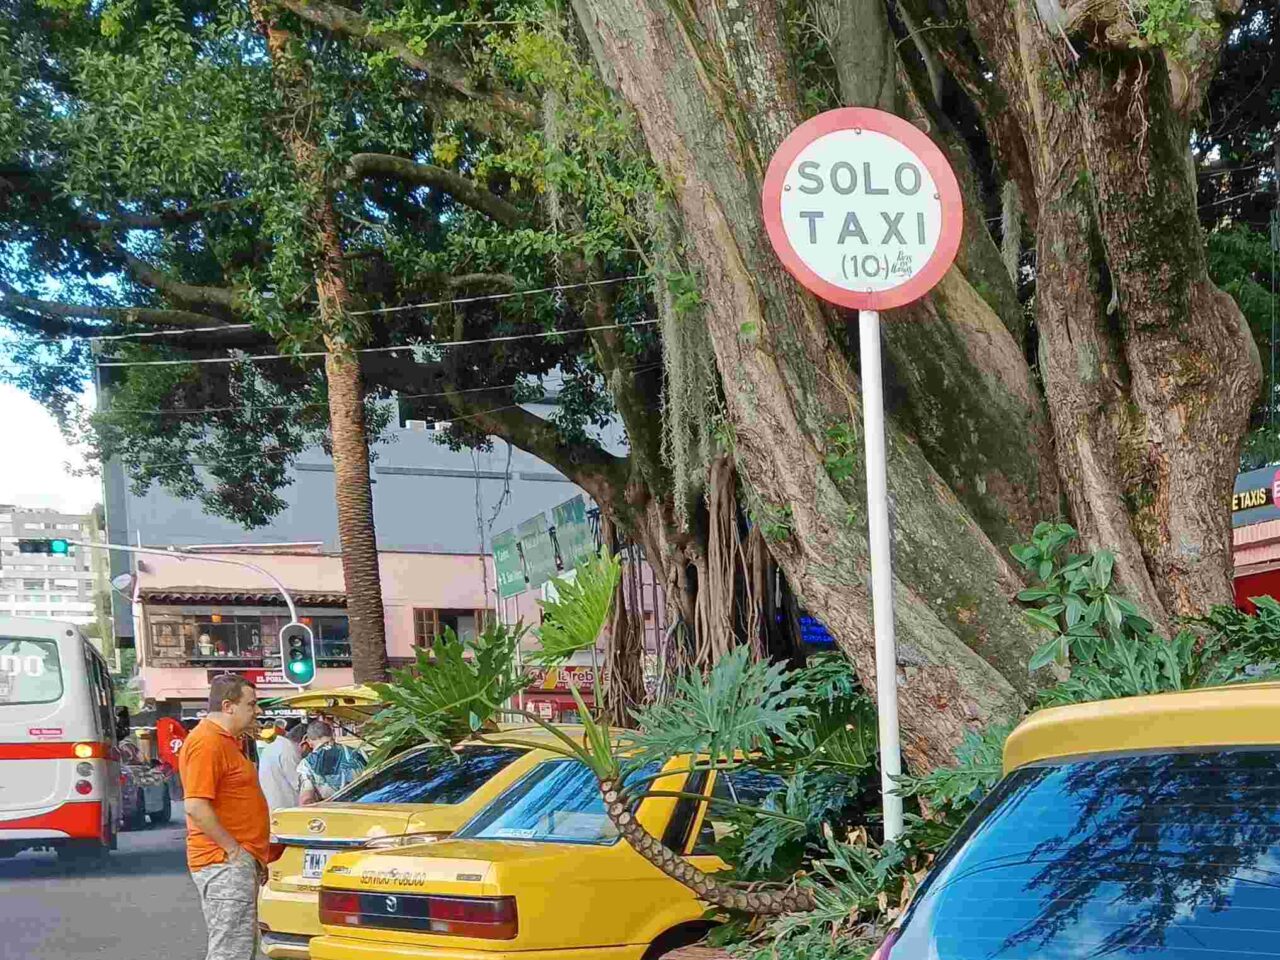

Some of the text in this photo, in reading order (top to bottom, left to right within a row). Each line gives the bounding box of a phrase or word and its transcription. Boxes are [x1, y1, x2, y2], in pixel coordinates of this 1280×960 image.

[797, 161, 922, 196] SOLO
[799, 211, 926, 245] TAXI
[841, 253, 890, 280] (10)
[1240, 487, 1267, 509] TAXIS
